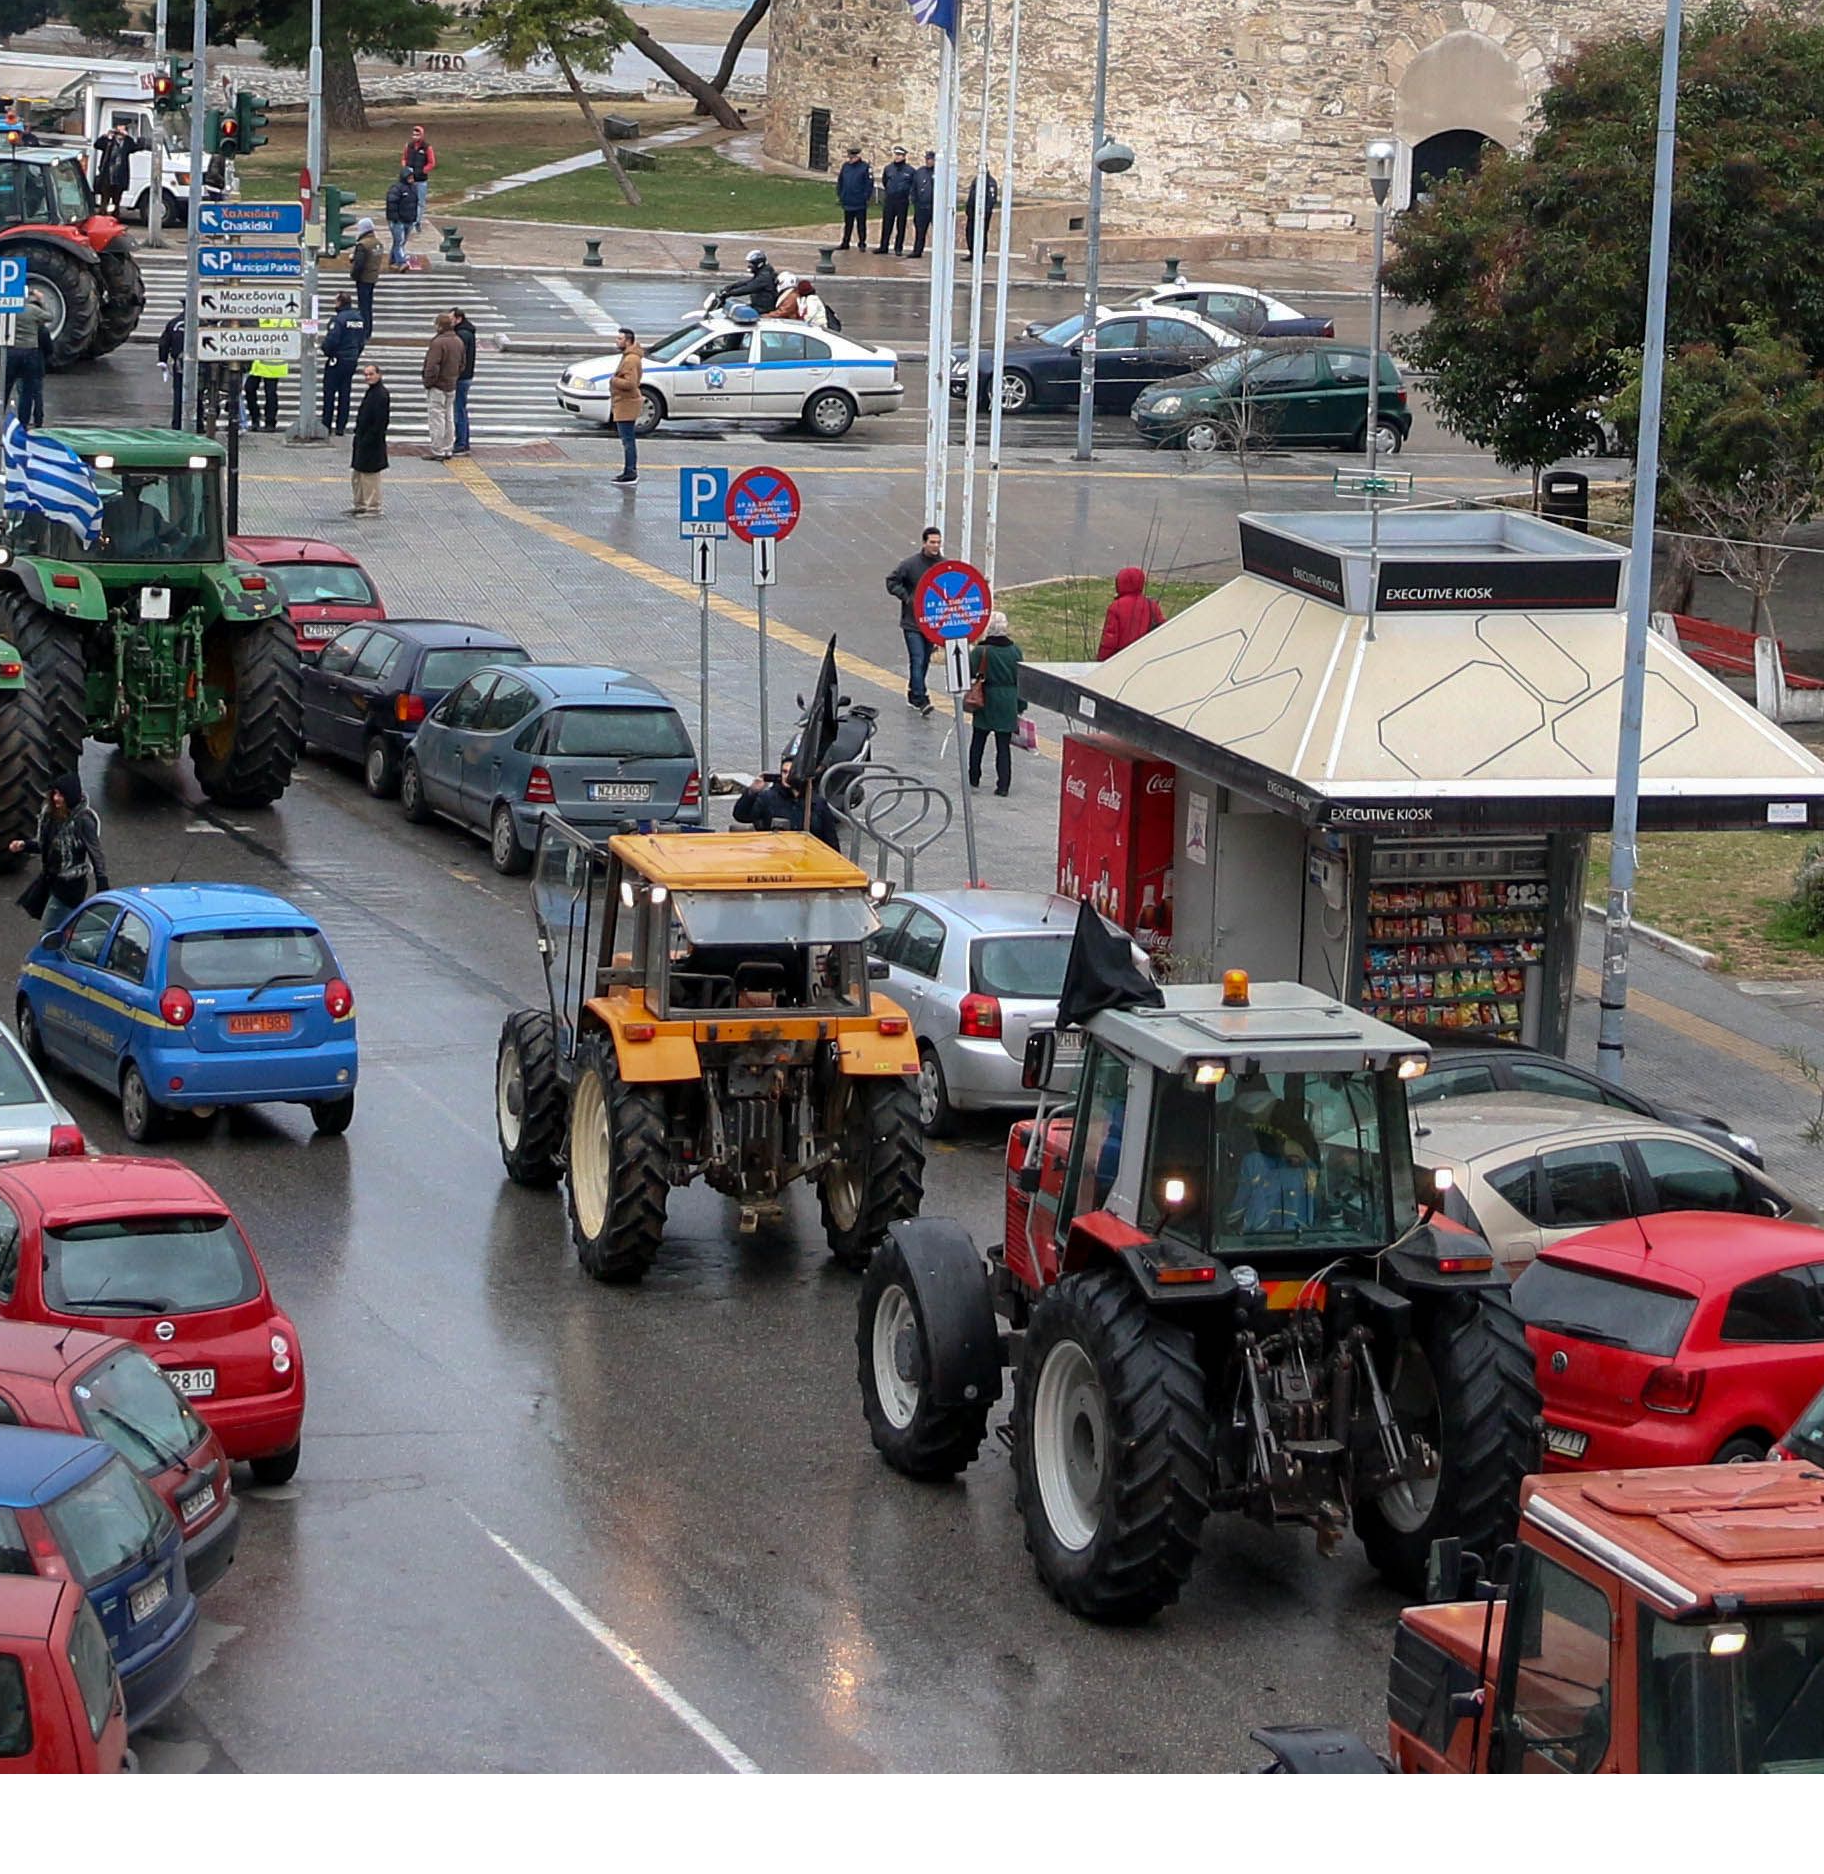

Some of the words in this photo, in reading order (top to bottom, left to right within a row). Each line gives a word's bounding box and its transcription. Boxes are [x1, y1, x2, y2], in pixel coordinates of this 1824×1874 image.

[221, 220, 273, 231] Chalkidiki
[219, 251, 232, 270] P
[232, 263, 269, 273] Municipal
[270, 262, 301, 274] Parking
[0, 260, 19, 294] P
[220, 290, 286, 301] Μακεδονία
[220, 304, 283, 315] Macedonia
[220, 331, 289, 344] Καλαμαριά
[220, 346, 281, 356] Kalamaria
[691, 473, 717, 517] P
[690, 523, 716, 533] ΤΑΞΙ
[1292, 566, 1323, 588] EXECUTIVE
[1322, 579, 1340, 595] KIOSK
[1386, 588, 1454, 601] EXECUTIVE
[1455, 587, 1493, 600] KIOSK
[1331, 808, 1395, 821] EXECUTIVE
[1396, 808, 1433, 821] KIOSK
[747, 874, 793, 884] RENAULT
